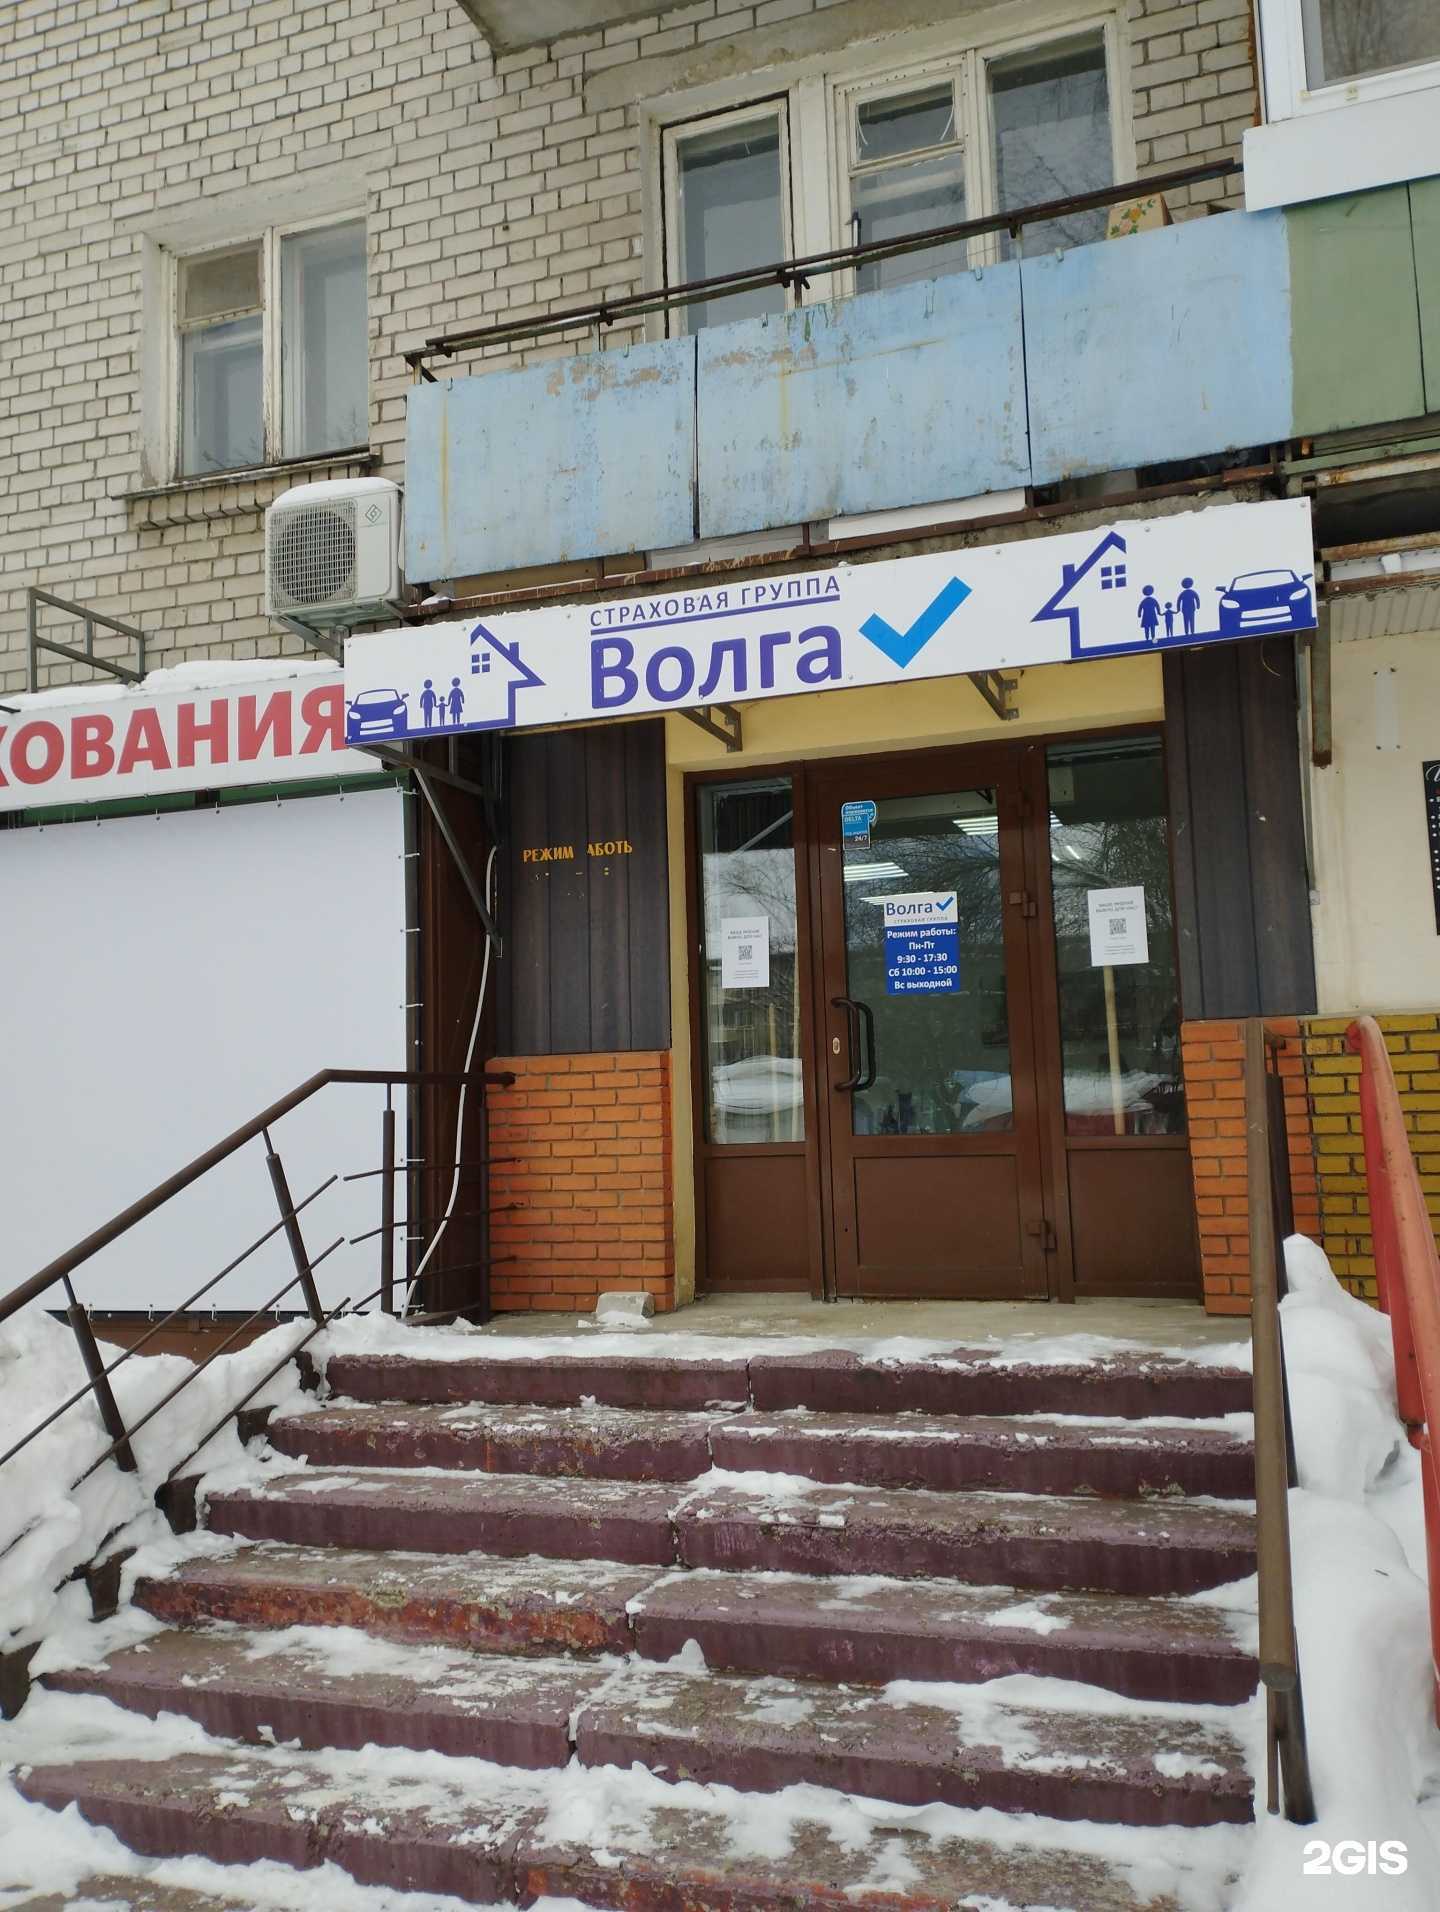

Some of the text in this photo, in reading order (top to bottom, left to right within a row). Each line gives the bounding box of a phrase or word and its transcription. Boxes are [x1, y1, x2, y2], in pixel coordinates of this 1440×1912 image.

[590, 575, 841, 627] СТРАХОВАЯ ГРУППА
[590, 624, 842, 710] Волга
[523, 845, 574, 862] РЕЖИМ
[886, 902, 933, 916] Волга
[887, 927, 957, 939] Режим работы:
[908, 941, 935, 950] Пн-Пт
[896, 955, 916, 964] 9:30
[923, 953, 948, 962] 17:30
[888, 967, 900, 977] Сб
[902, 966, 926, 976] 10:00
[933, 965, 958, 975] 15:00
[894, 978, 953, 989] Вс выходной
